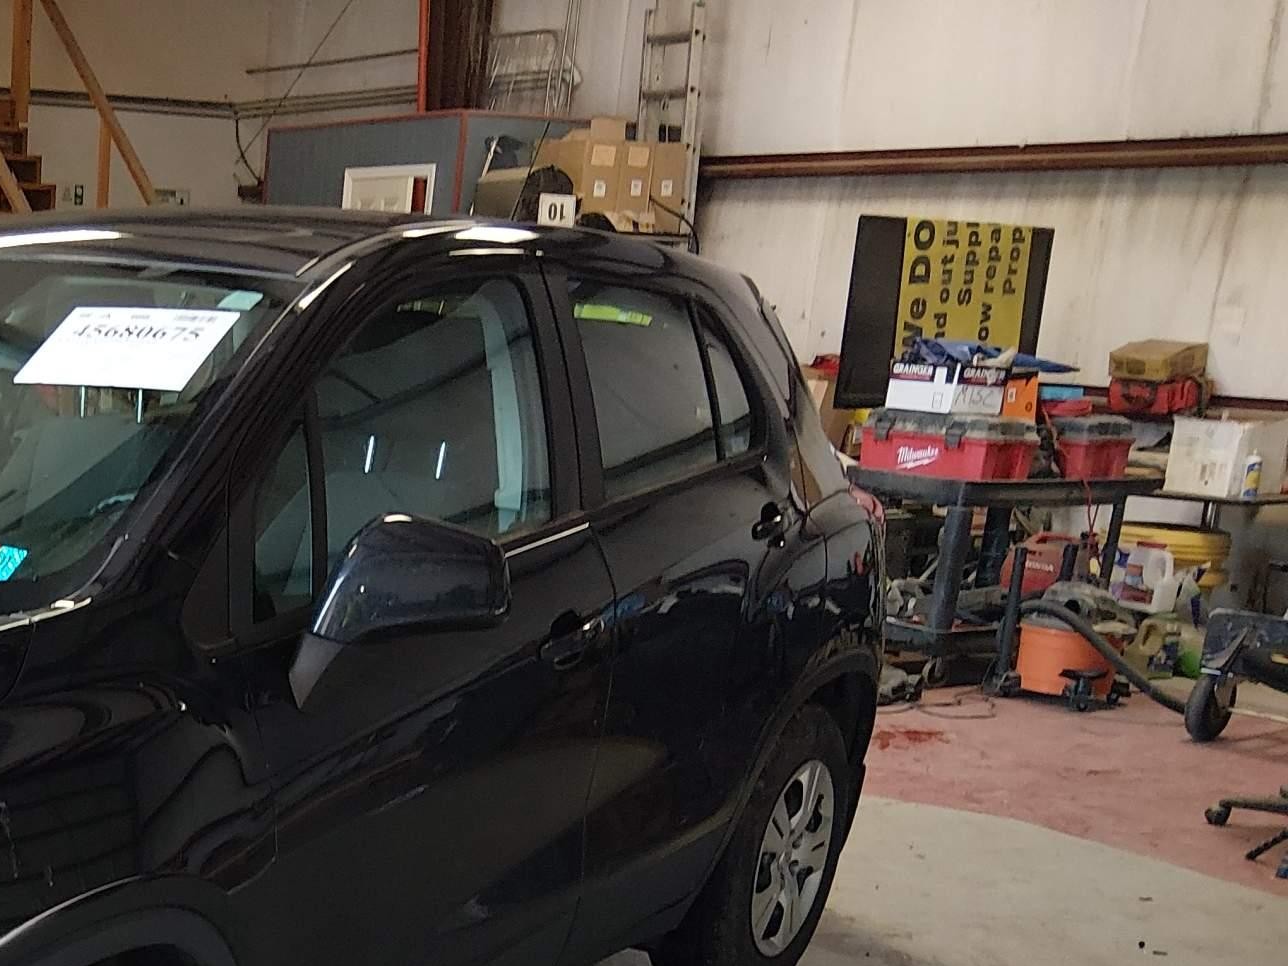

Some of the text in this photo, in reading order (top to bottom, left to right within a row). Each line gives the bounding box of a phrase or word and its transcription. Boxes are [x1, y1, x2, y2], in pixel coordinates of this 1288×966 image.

[908, 219, 936, 284] DO
[1002, 226, 1026, 296] Prop
[939, 253, 955, 304] out
[73, 323, 205, 341] 45680675
[893, 362, 934, 376] GRAINGER
